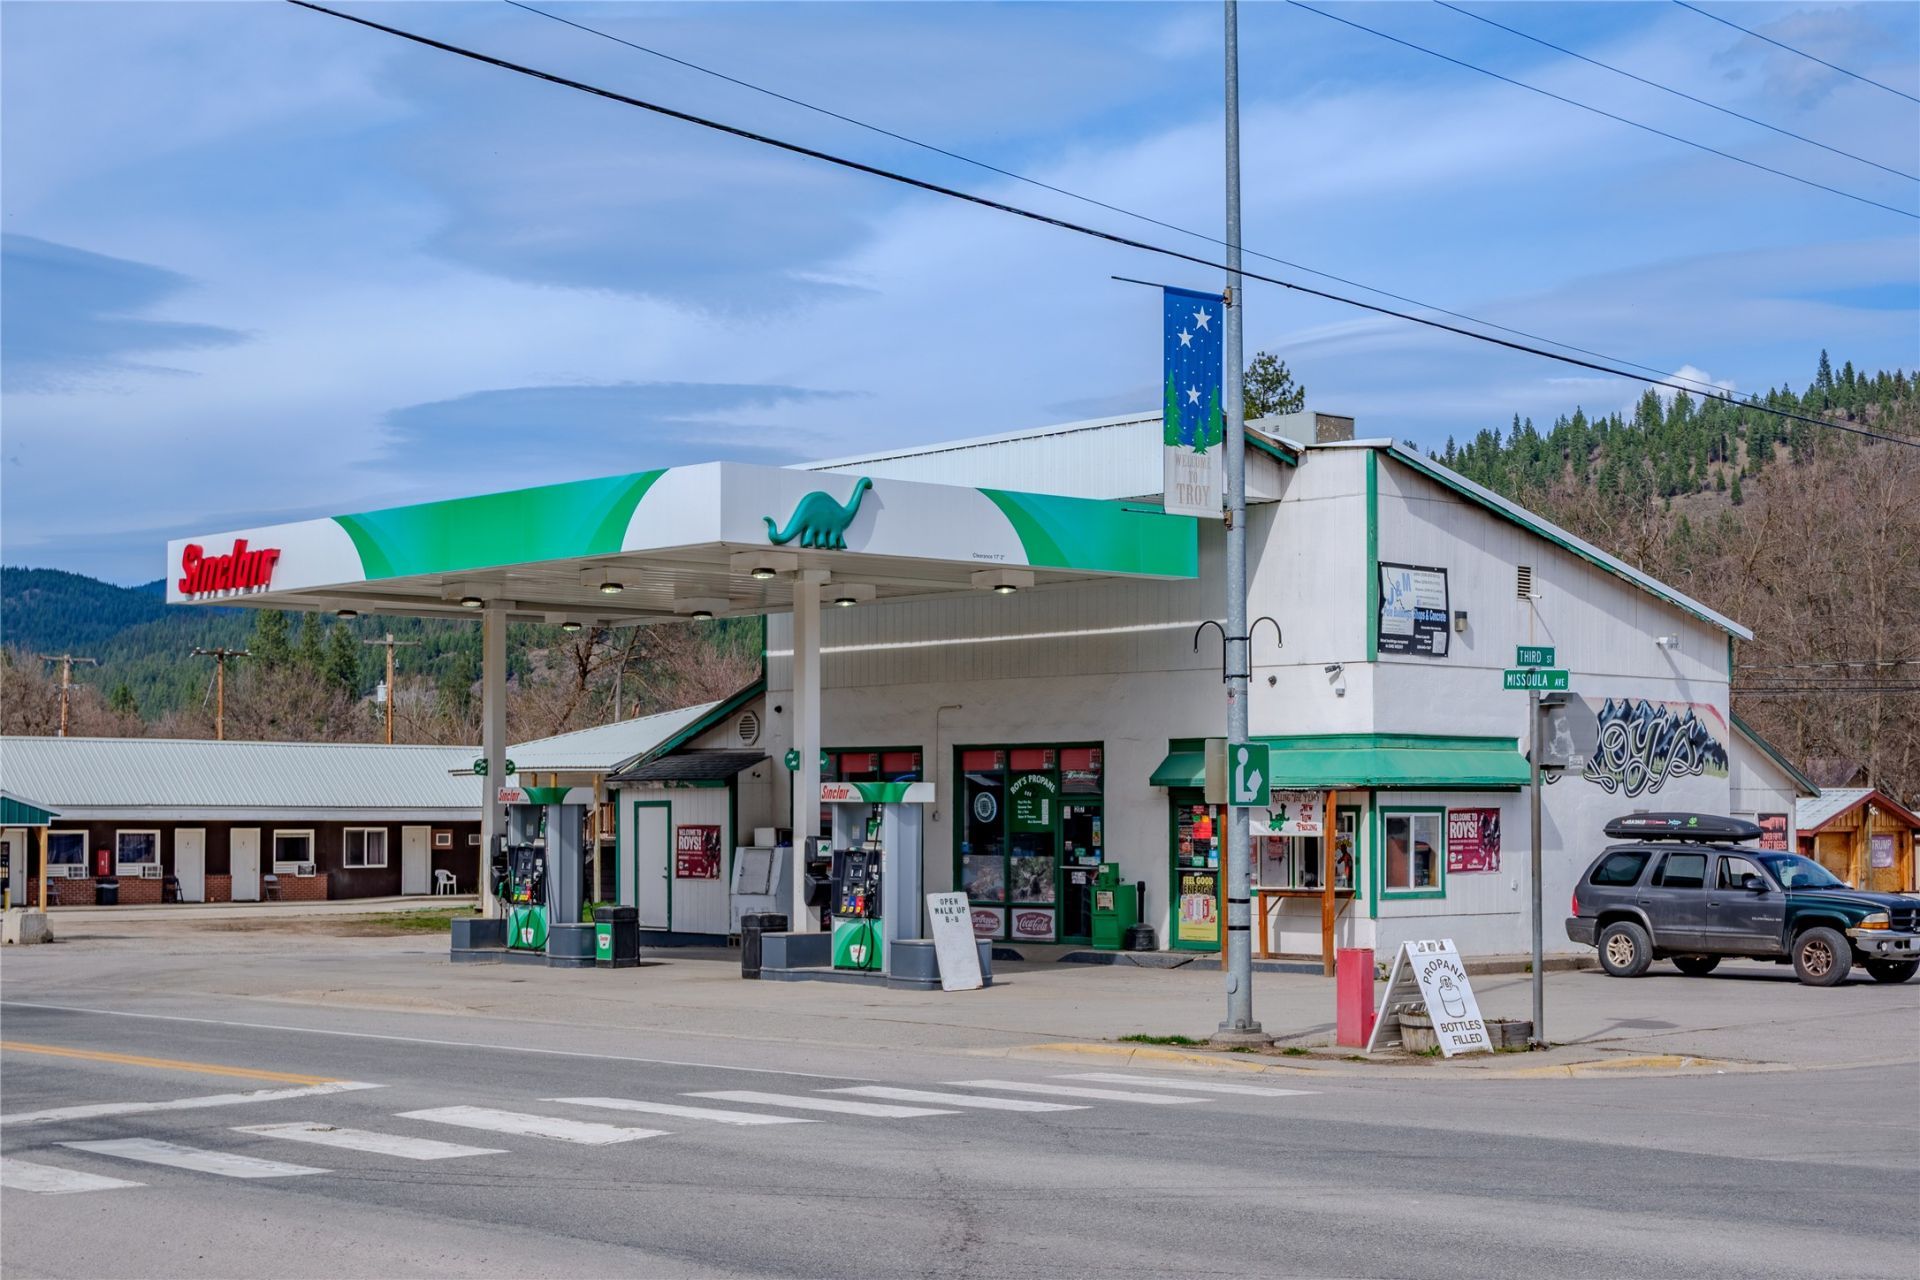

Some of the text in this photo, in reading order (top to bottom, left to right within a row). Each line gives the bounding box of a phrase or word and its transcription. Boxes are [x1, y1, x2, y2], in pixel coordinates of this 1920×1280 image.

[1175, 454, 1211, 469] WELCOME
[1189, 471, 1198, 484] TO
[1177, 483, 1210, 507] TROY
[179, 538, 281, 595] Sinclair
[1387, 587, 1395, 606] J
[1402, 572, 1412, 593] M
[1519, 650, 1553, 664] THIRD ST
[1506, 673, 1566, 687] MISSOULA AVE
[1009, 774, 1056, 795] ROY'S PROPANE
[499, 788, 520, 802] Sinclair
[821, 785, 850, 800] Sinclair
[1450, 812, 1471, 821] WELCOME
[1450, 821, 1478, 839] ROYS!
[678, 835, 702, 851] ROYS!
[1760, 840, 1788, 850] CRAFT BEERS
[1872, 839, 1892, 850] TRUMP
[1183, 876, 1214, 886] FEEL GOOD
[1183, 884, 1213, 895] ENERGY
[940, 897, 959, 906] OPEN
[934, 906, 966, 915] WALK UP
[1423, 958, 1467, 986] PROPANE
[1440, 1020, 1482, 1034] BOTTLES
[1452, 1033, 1483, 1046] FILLED
